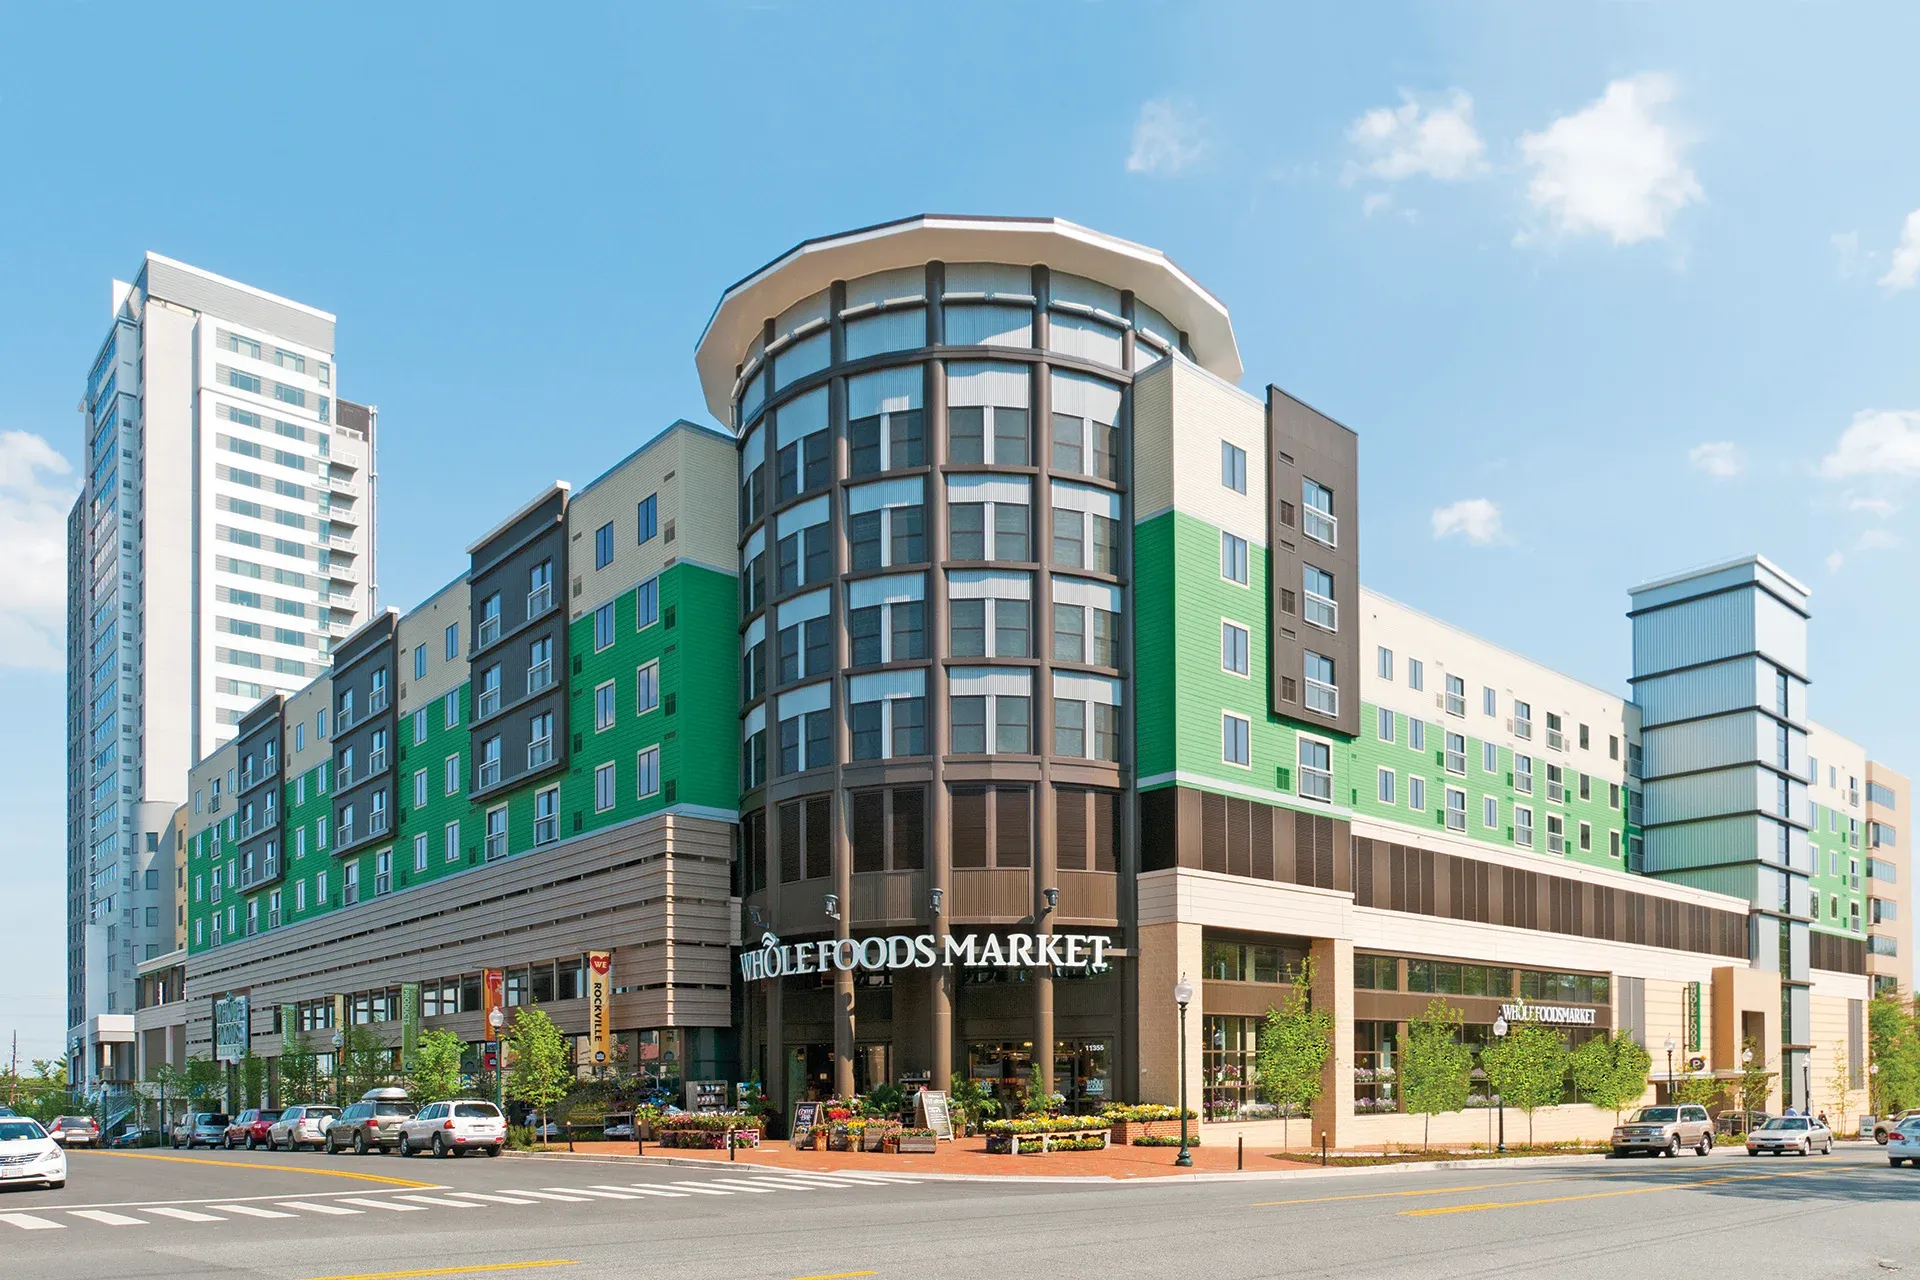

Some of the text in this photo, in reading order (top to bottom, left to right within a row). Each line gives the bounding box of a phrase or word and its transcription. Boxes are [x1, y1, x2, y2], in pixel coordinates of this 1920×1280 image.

[594, 961, 607, 969] WE
[740, 932, 1112, 982] WHOLE FOODS MARKET
[594, 982, 602, 1042] ROCKVILLE
[1502, 998, 1534, 1021] WHOLE
